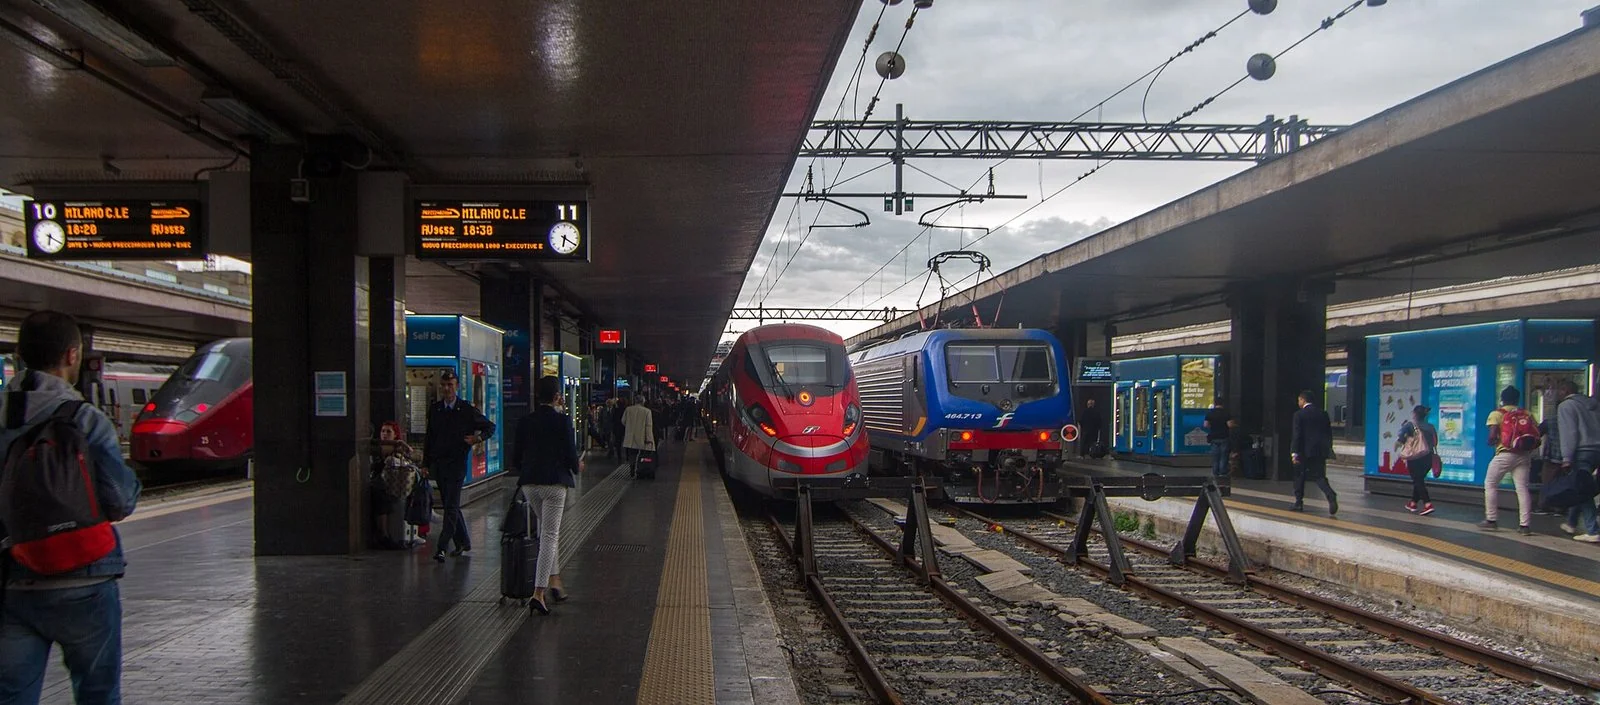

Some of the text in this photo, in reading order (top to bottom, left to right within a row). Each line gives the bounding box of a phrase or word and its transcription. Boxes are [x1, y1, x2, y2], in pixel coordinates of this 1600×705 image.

[33, 203, 57, 220] 10
[65, 207, 129, 219] MILANO C.LE
[462, 208, 501, 219] MILANO
[503, 208, 526, 220] C.LE
[558, 204, 577, 220] 11
[67, 224, 97, 235] 18:20
[463, 225, 493, 236] 18:30
[412, 332, 446, 340] Self Bar
